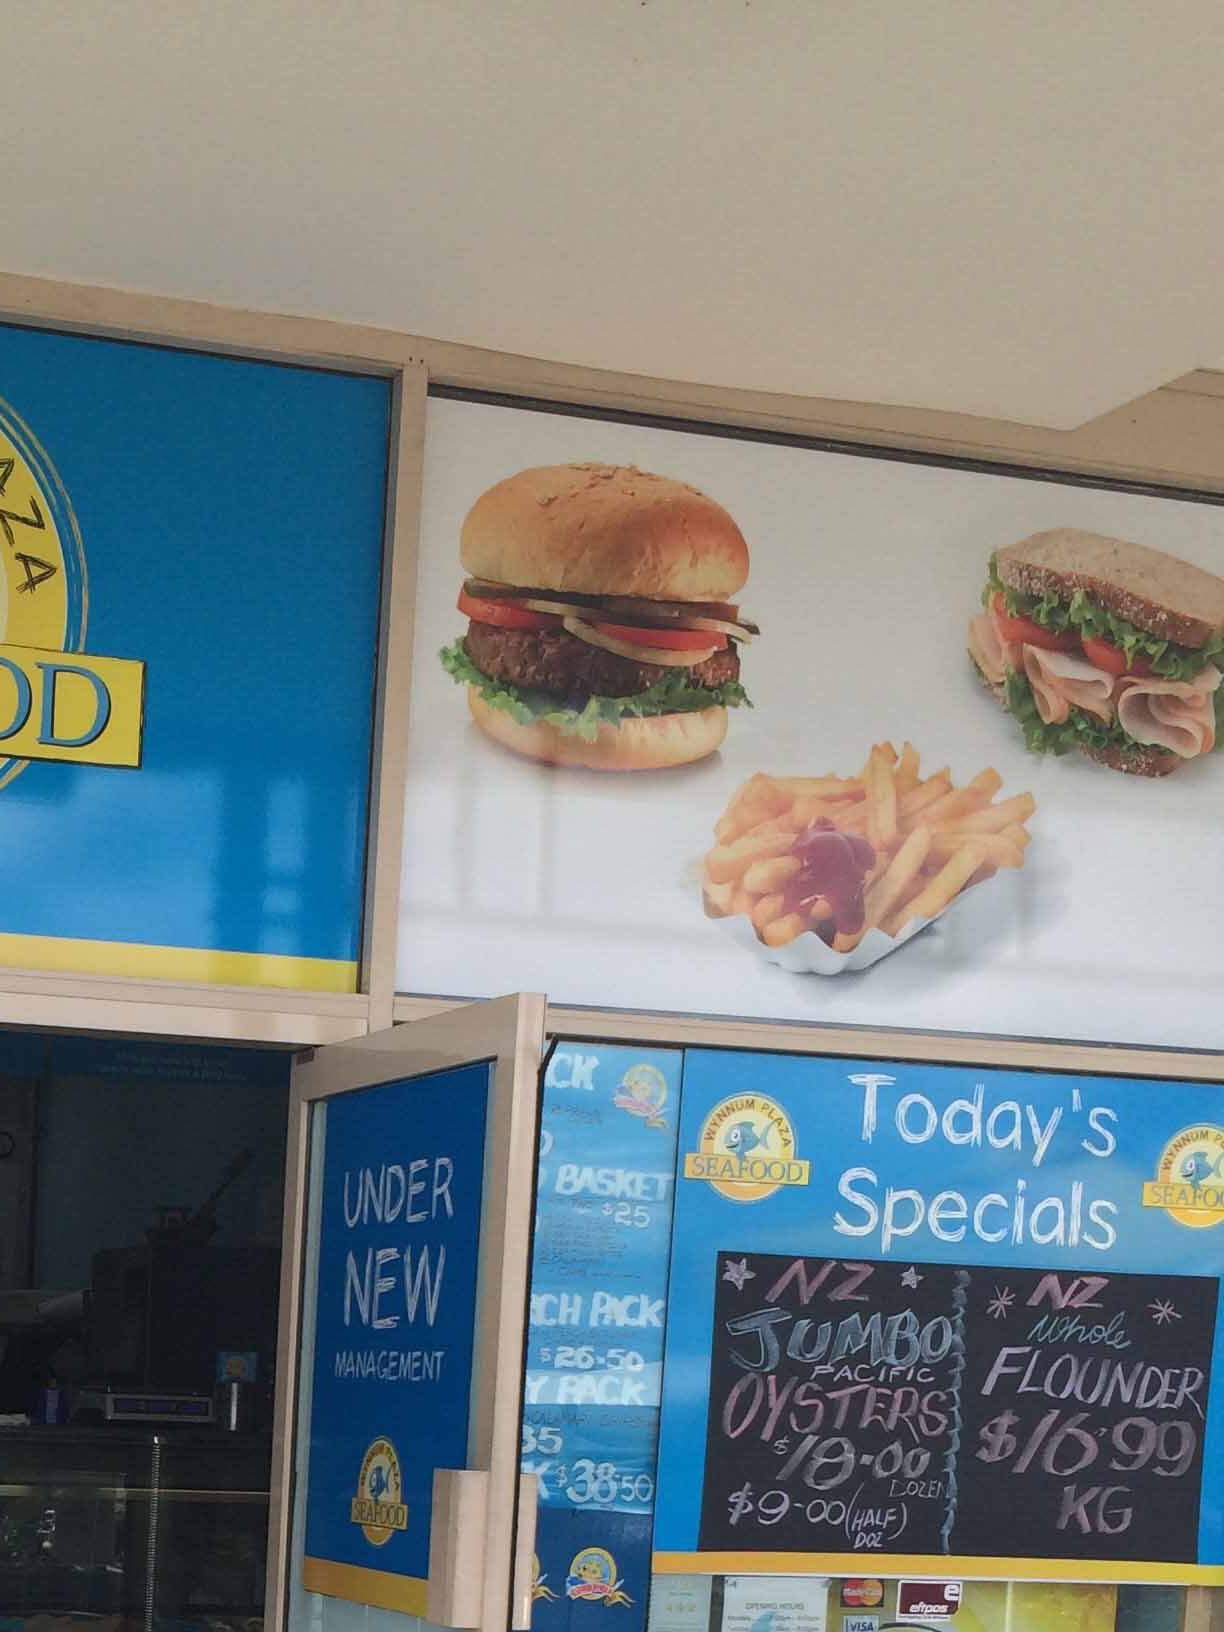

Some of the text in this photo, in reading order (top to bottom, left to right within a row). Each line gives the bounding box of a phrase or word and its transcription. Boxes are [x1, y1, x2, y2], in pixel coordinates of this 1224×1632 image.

[703, 1098, 793, 1149] WYNNUM PLAZA
[847, 1072, 1118, 1168] Today's
[554, 1163, 675, 1201] BASKET
[691, 1154, 804, 1183] SEAFOOD
[342, 1155, 456, 1230] UNDER
[832, 1165, 1119, 1254] Specials
[1151, 1183, 1224, 1209] SEAFO
[342, 1244, 447, 1330] NEW
[764, 1258, 876, 1305] NZ
[1025, 1273, 1112, 1310] NZ
[589, 1290, 665, 1328] PACK
[725, 1305, 953, 1374] JUMBO
[334, 1347, 446, 1385] MANAGEMENT
[808, 1362, 936, 1384] PACIFIC
[980, 1345, 1206, 1421] FLOUNDER
[556, 1374, 648, 1406] PACK
[720, 1371, 951, 1443] OYSTERS
[1054, 1484, 1135, 1536] KG
[849, 1621, 875, 1632] VISA
